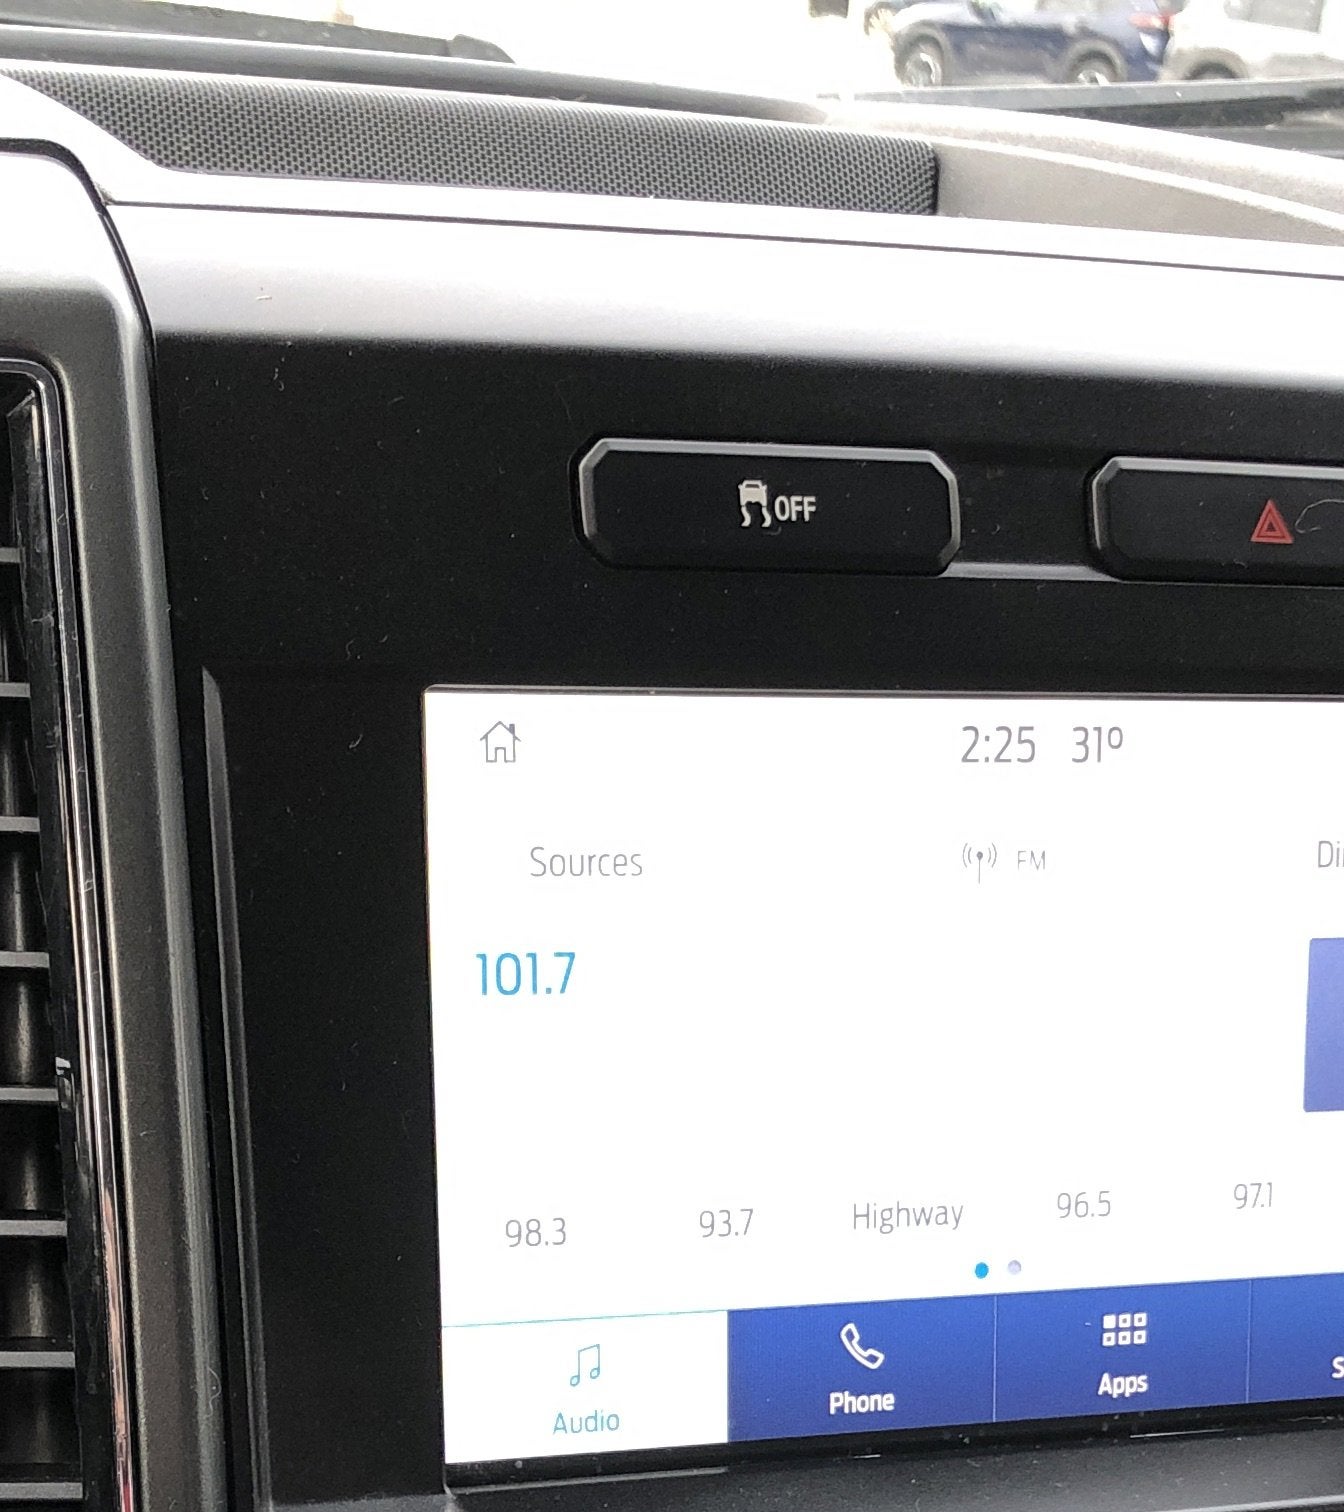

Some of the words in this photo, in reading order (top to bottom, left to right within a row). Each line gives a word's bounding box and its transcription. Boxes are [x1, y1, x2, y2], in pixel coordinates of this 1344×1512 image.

[774, 495, 817, 522] OFF
[960, 725, 1036, 764] 2:25
[529, 846, 643, 878] Sources
[1017, 850, 1046, 871] FM
[475, 951, 576, 996] 101.7
[1057, 1190, 1111, 1219] 96.5
[1233, 1181, 1273, 1210] 97.1
[699, 1208, 754, 1239] 93.7
[853, 1200, 964, 1235] Highway
[505, 1217, 567, 1248] 98.3
[1097, 1372, 1149, 1399] Apps
[829, 1390, 896, 1415] Phone
[552, 1409, 620, 1435] Audio
